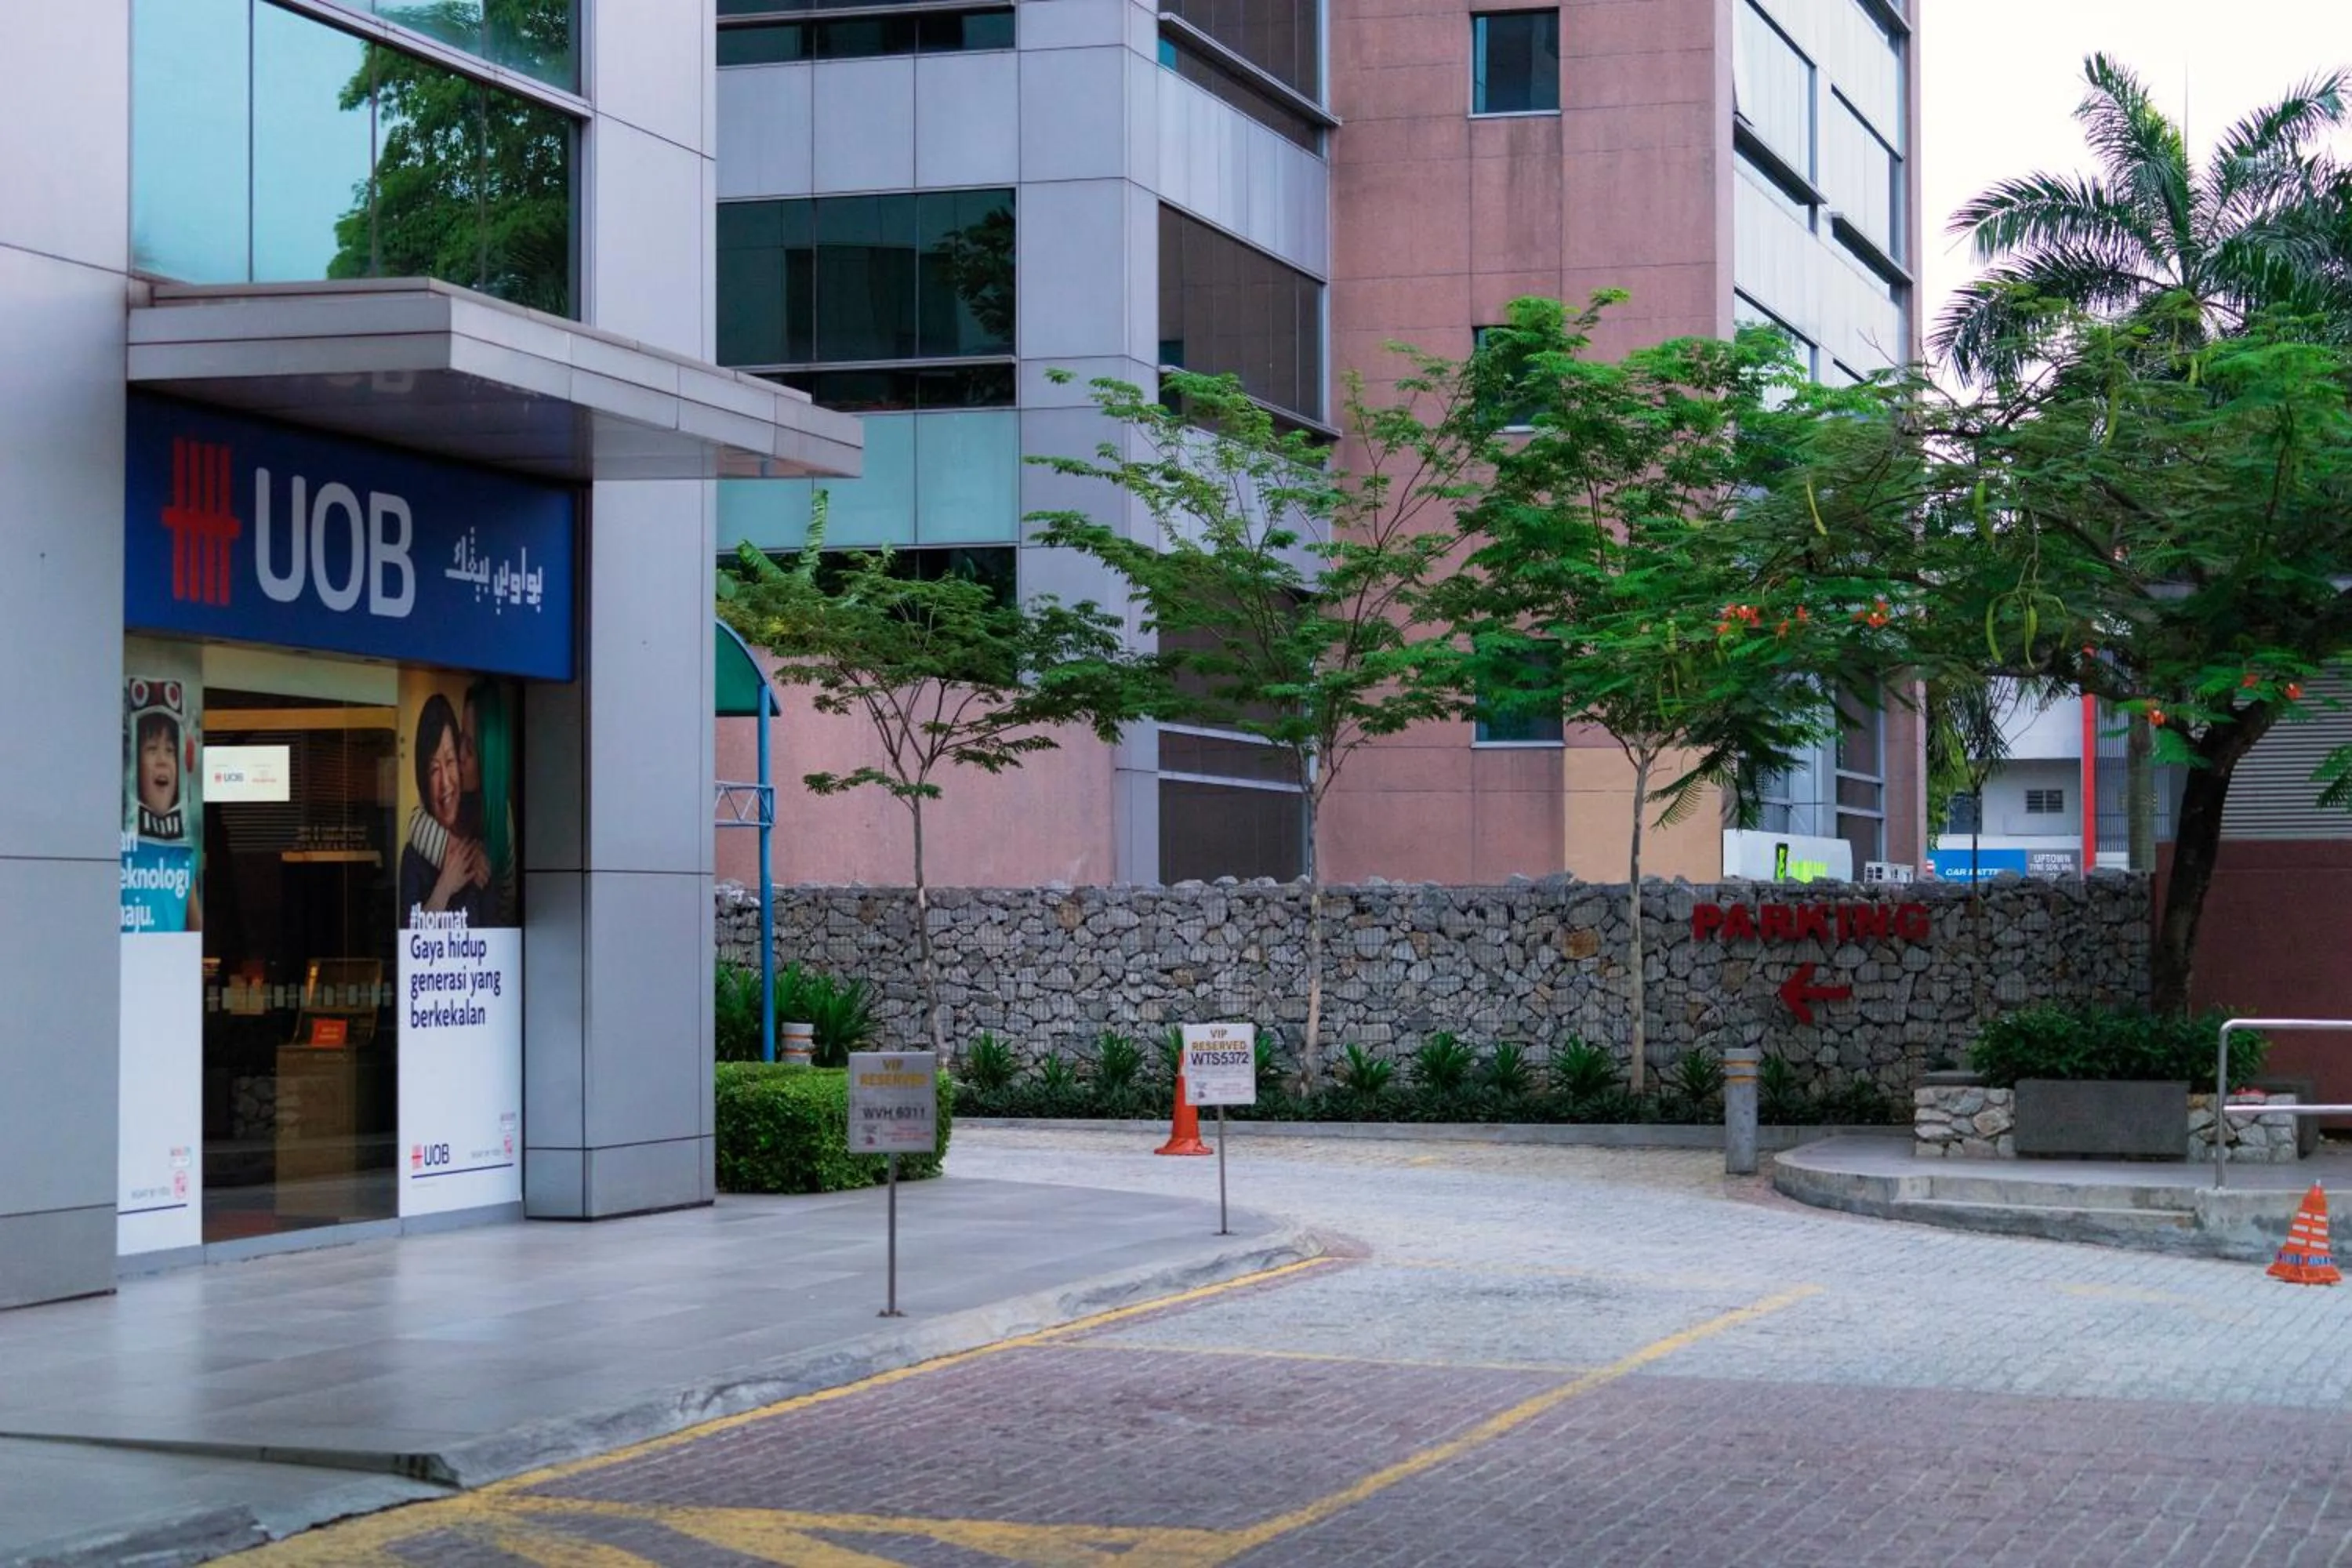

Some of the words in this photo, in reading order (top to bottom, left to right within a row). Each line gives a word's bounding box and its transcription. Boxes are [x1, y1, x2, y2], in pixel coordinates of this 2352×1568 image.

[255, 467, 416, 618] UOB
[1945, 868, 1967, 877] CAR
[409, 902, 468, 930] #hormat
[1692, 902, 1932, 944] PARKING
[410, 934, 445, 967] Gaya
[448, 931, 487, 967] hidup
[410, 965, 467, 1000] generasi
[470, 970, 502, 998] yang
[410, 999, 486, 1029] berkekalan
[1191, 1040, 1247, 1051] RESERVED
[1209, 1028, 1229, 1039] VIP
[882, 1058, 904, 1071] VIP
[1190, 1051, 1249, 1065] WTS5372
[424, 1143, 450, 1166] UOB
